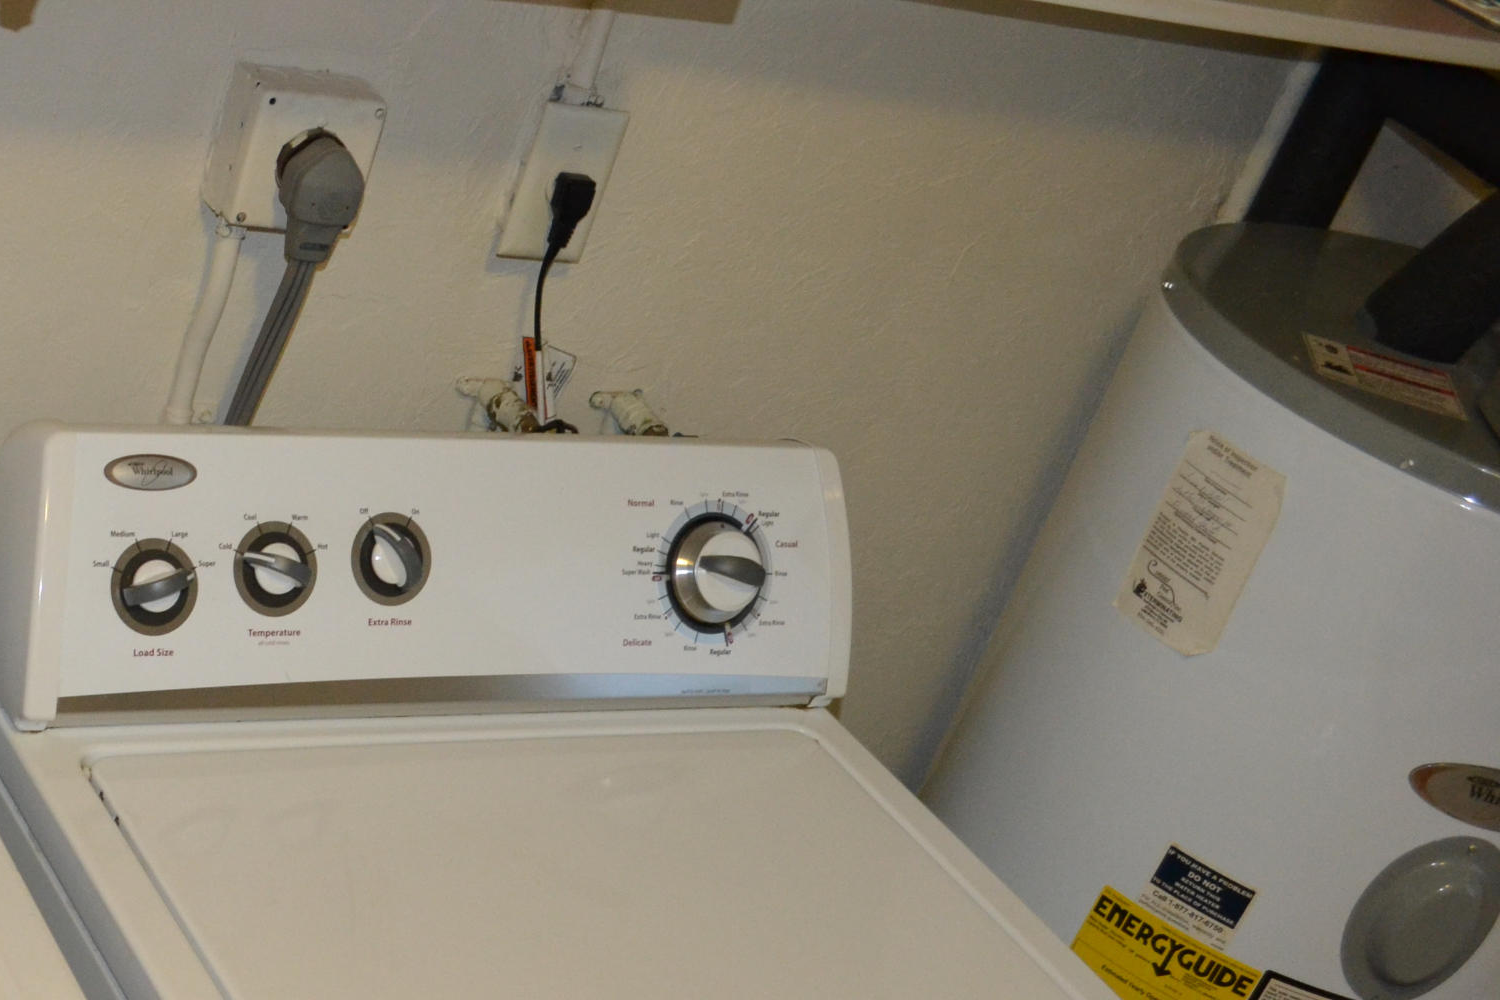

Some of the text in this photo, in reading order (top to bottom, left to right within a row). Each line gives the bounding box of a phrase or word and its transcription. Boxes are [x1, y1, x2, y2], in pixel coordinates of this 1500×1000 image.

[627, 498, 655, 507] Normal
[758, 510, 780, 518] Regular
[110, 530, 135, 538] Medium
[171, 530, 188, 539] Large
[218, 542, 233, 550] Cold
[775, 540, 798, 548] Casual
[632, 545, 655, 554] Regular
[93, 560, 110, 568] Small
[198, 560, 216, 568] Super
[368, 617, 412, 626] Extra Rinse
[248, 628, 301, 639] Temperature
[622, 639, 652, 647] Delicate
[133, 648, 174, 657] Load Size
[709, 648, 732, 657] Regular
[1176, 853, 1191, 866] YOU
[1190, 861, 1211, 877] HAVE
[1217, 877, 1252, 899] PROBLEM
[1186, 870, 1222, 894] DO NOT
[1151, 889, 1168, 902] Call
[1093, 894, 1254, 998] ENERGYGUIDE
